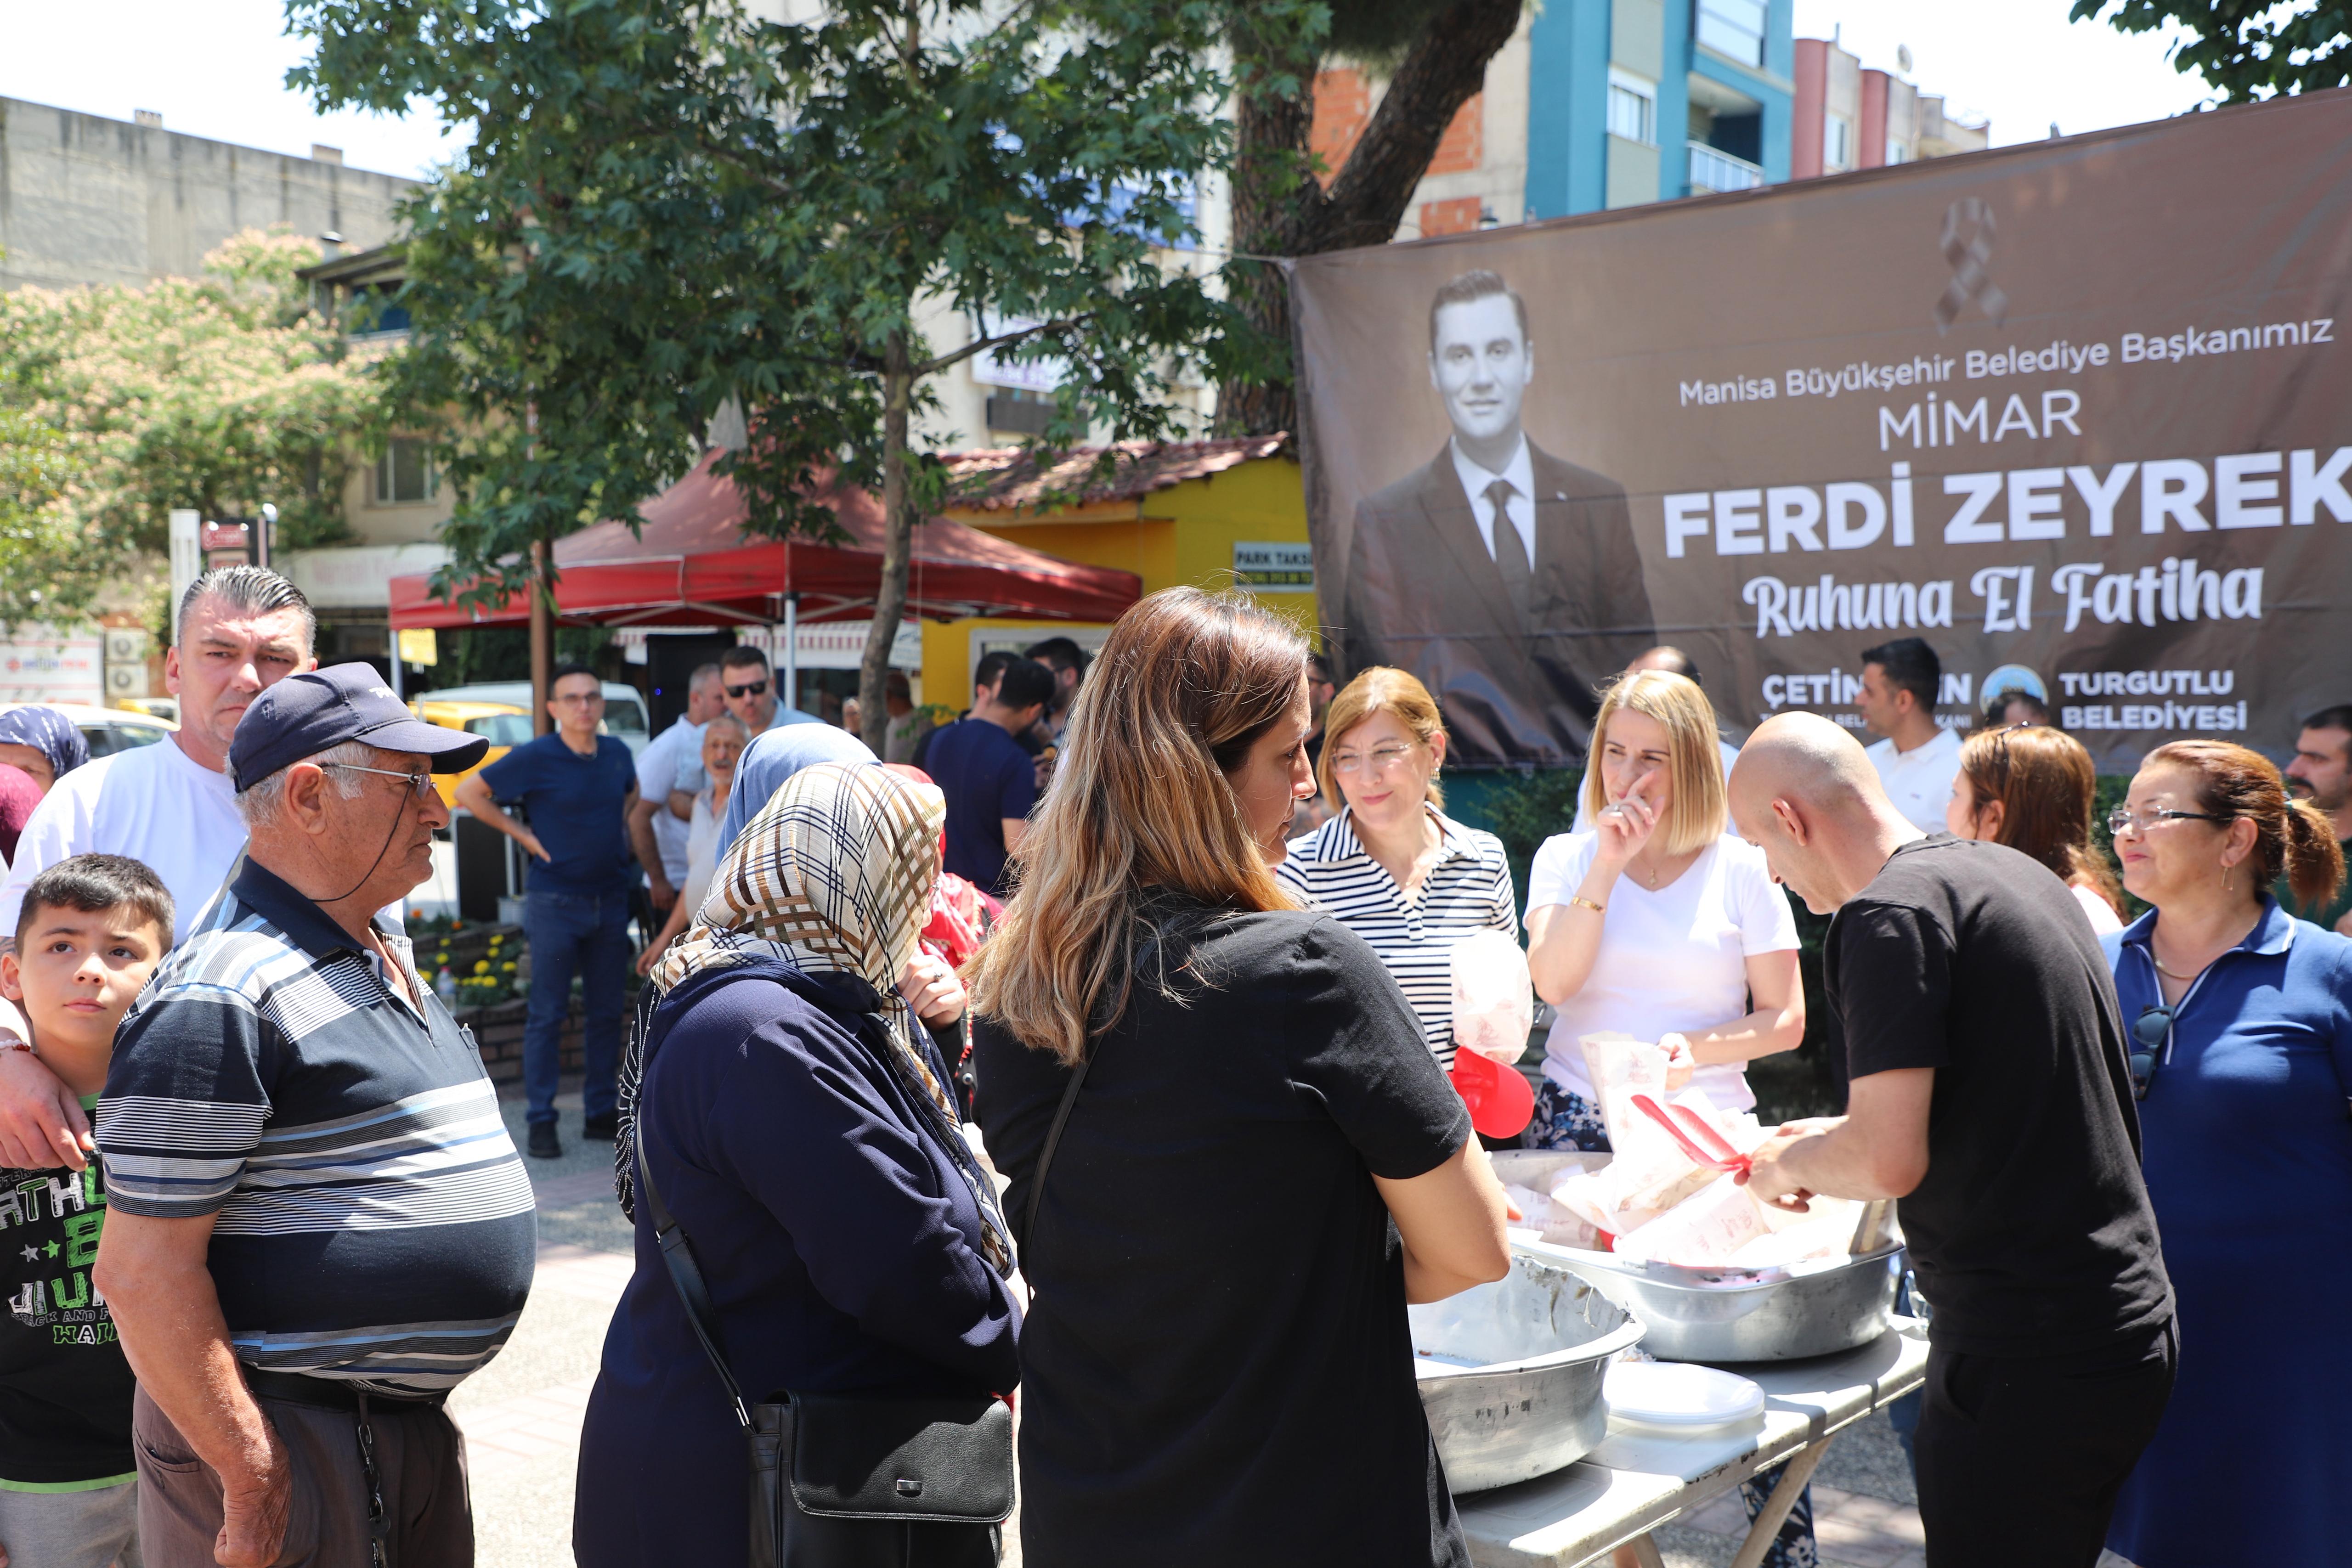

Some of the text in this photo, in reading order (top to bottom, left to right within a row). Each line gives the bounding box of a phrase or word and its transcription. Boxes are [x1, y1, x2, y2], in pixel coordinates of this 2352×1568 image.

[1679, 318, 2334, 406] Manisa Büyükşehir Belediye Başkanımız
[1879, 389, 2082, 451] MİMAR
[1663, 446, 2352, 559] FERDİ ZEYREK
[1237, 552, 1270, 564] PARK
[1742, 556, 2265, 638] Ruhuna El Fatiha
[1762, 668, 1864, 710] ÇETİN
[2058, 670, 2234, 697] TURGUTLU
[2062, 699, 2248, 731] BELEDİYESİ
[62, 1309, 96, 1322] AND
